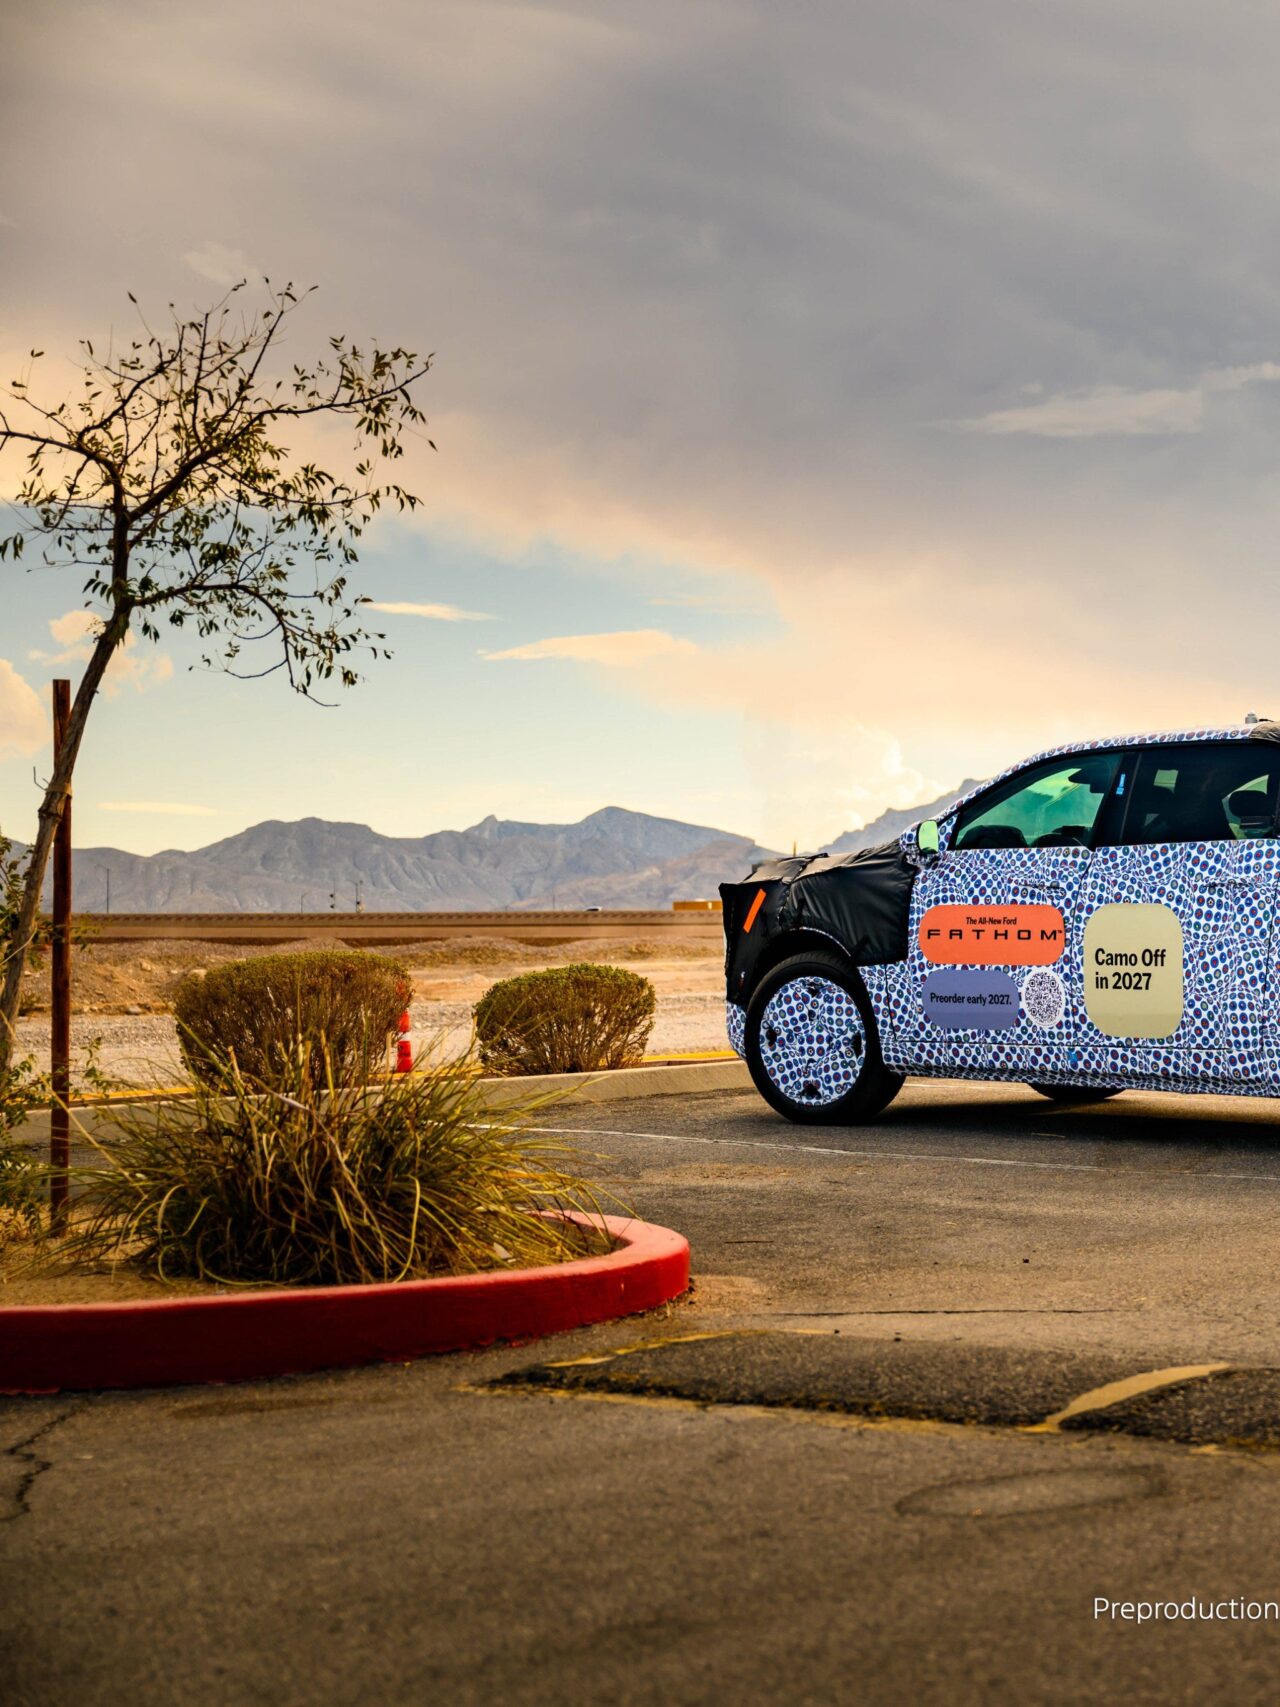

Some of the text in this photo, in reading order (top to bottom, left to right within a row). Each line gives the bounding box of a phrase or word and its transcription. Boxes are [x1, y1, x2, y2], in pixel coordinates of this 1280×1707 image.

[966, 917, 1017, 925] The All-New Ford
[1095, 947, 1166, 967] Camo Off
[1095, 972, 1152, 990] in 2027
[930, 992, 1012, 1006] Preorder early 2027.
